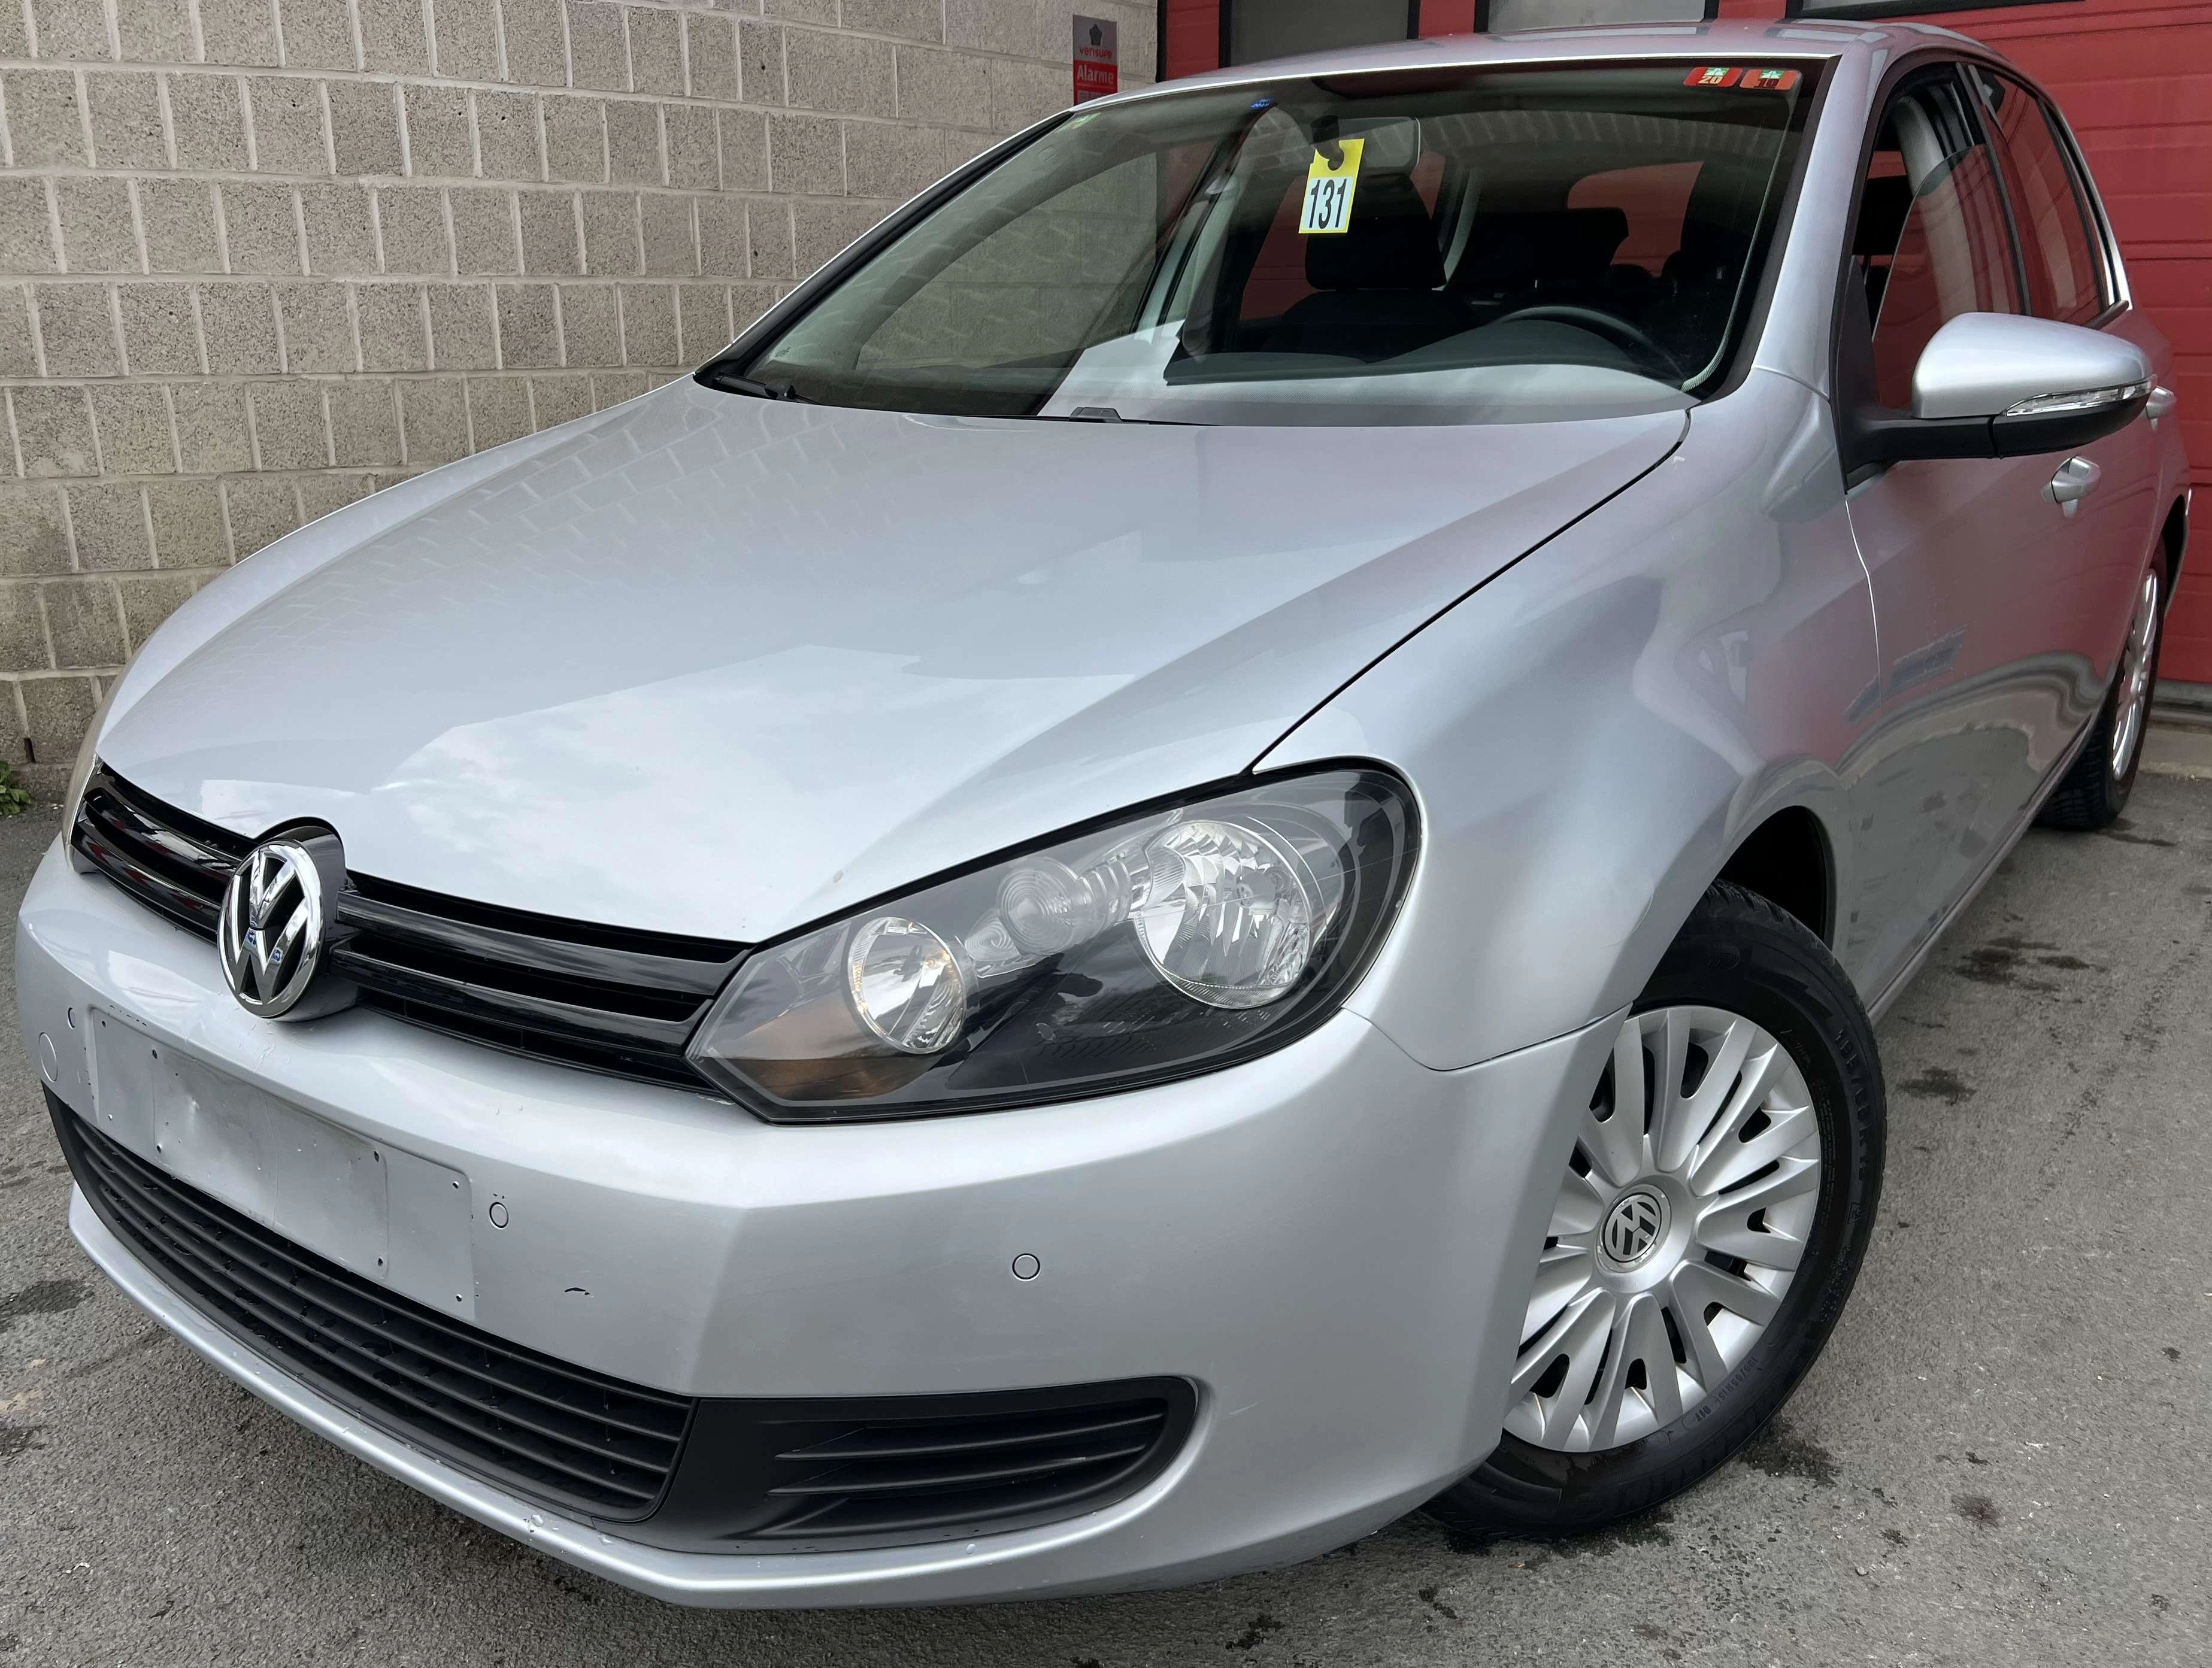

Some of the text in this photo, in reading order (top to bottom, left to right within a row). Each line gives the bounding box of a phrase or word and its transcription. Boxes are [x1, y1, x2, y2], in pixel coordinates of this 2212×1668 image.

[1077, 65, 1114, 84] Alarme
[1698, 75, 1723, 84] 20
[1309, 178, 1347, 229] 131
